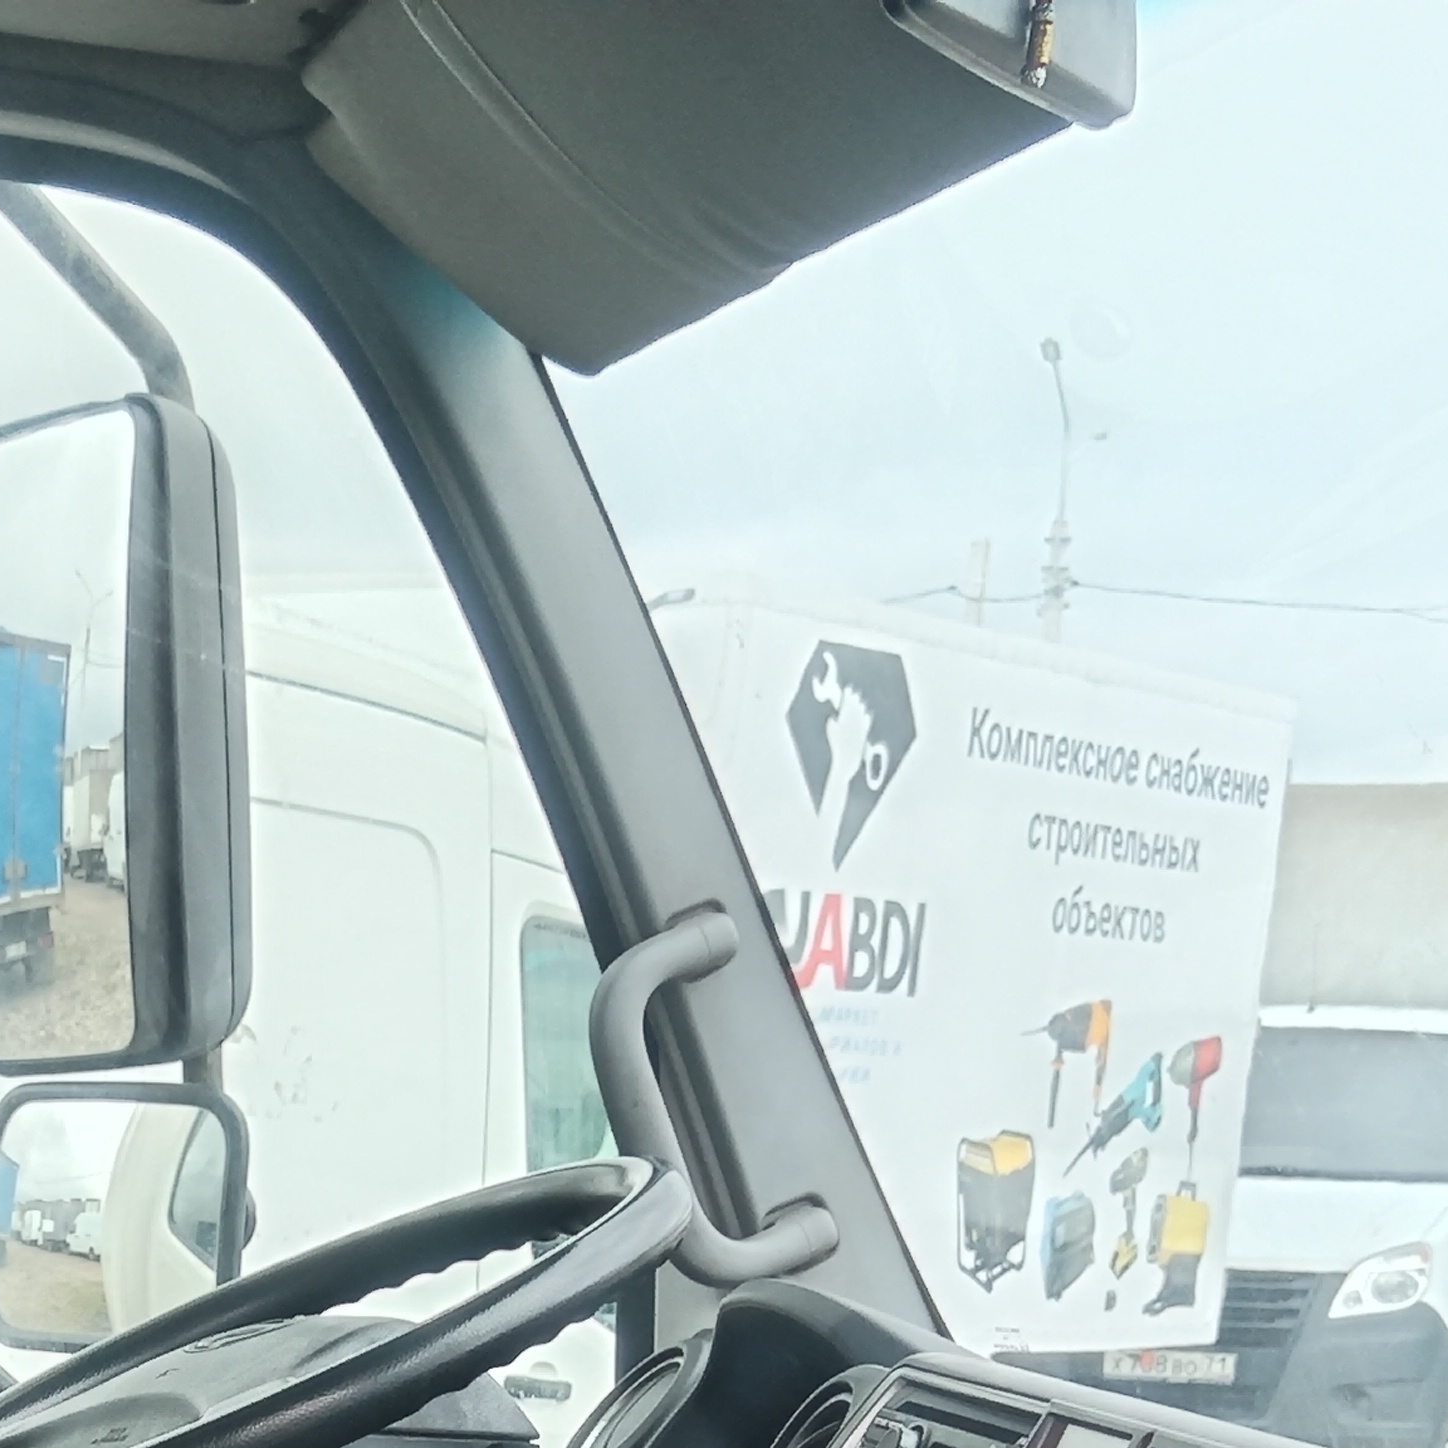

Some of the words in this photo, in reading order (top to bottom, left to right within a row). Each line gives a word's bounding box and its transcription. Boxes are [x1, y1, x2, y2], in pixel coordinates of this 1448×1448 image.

[967, 706, 1140, 787] Комплексное
[1144, 747, 1270, 809] снабжение
[1027, 812, 1201, 874] строительных
[1051, 884, 1166, 944] объектов
